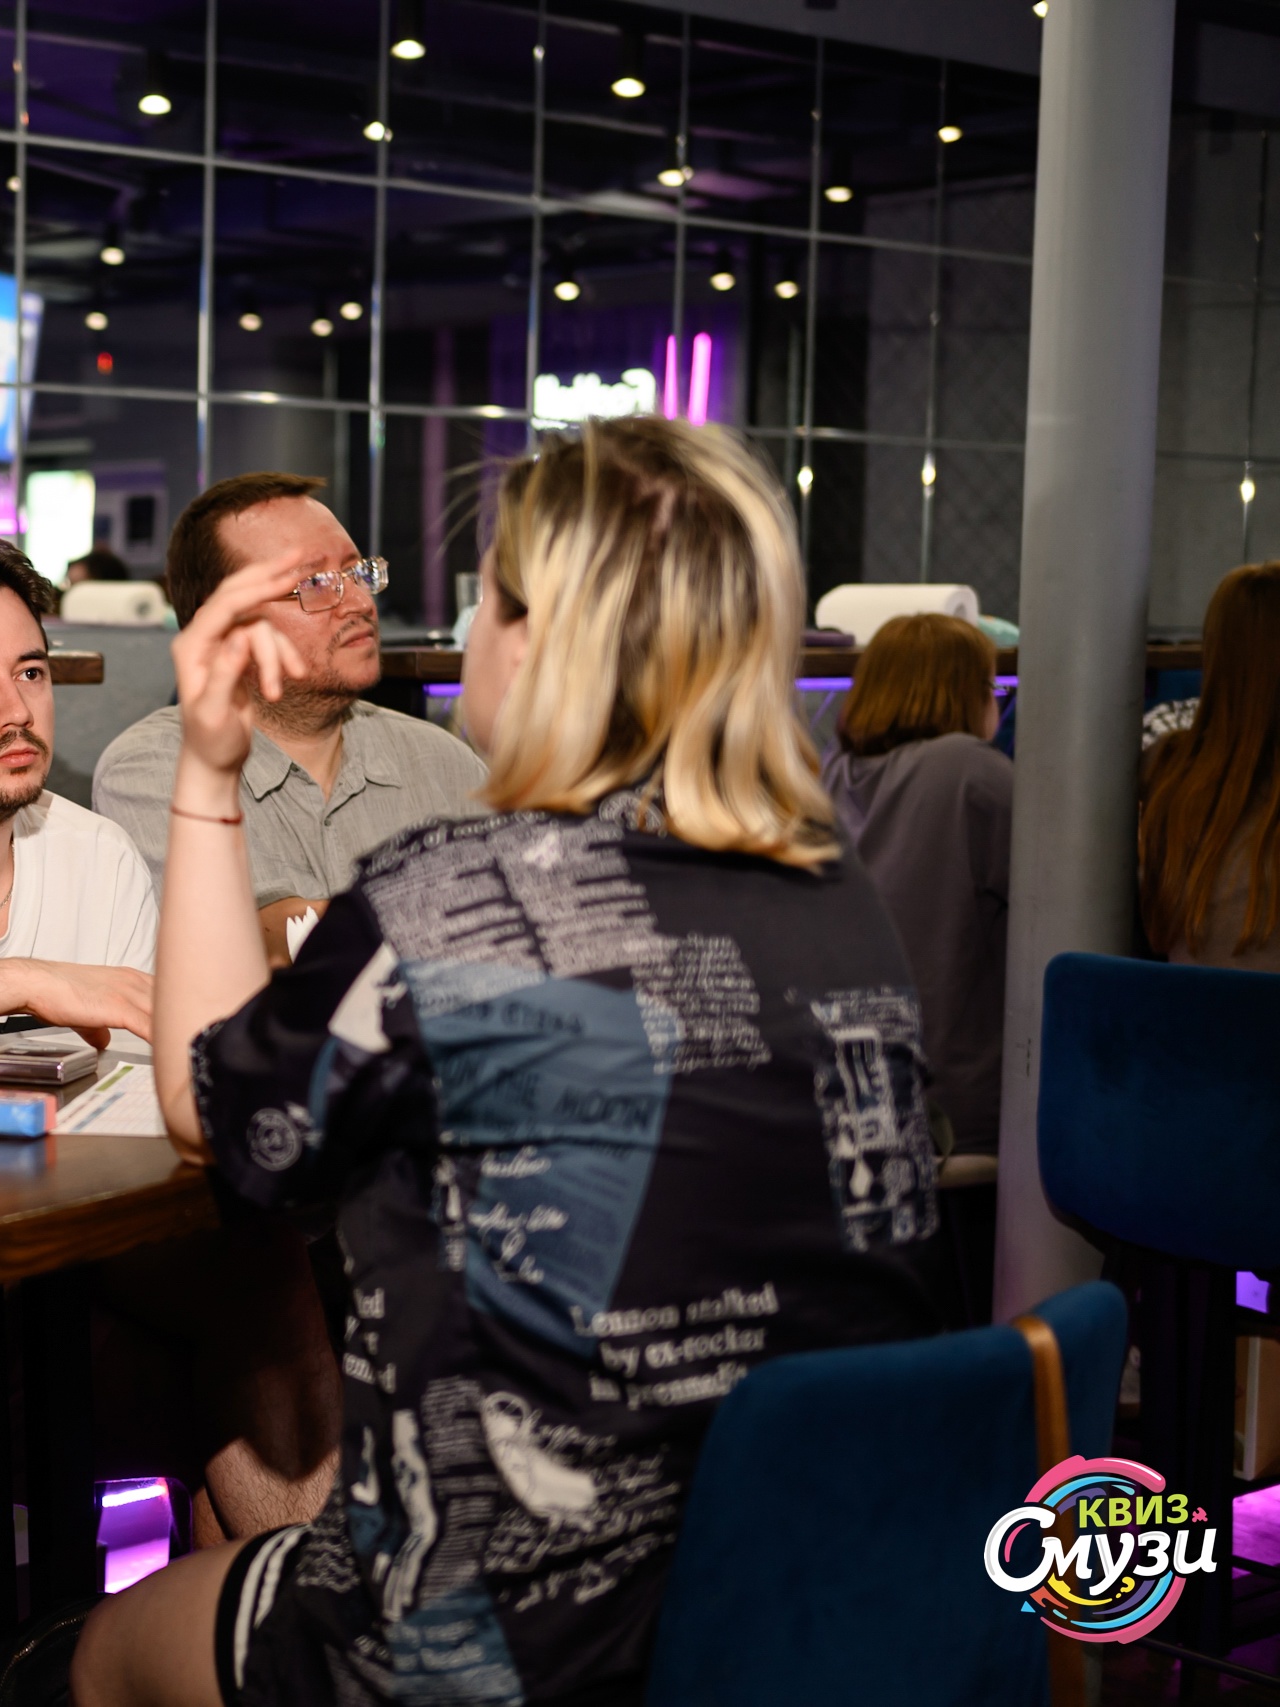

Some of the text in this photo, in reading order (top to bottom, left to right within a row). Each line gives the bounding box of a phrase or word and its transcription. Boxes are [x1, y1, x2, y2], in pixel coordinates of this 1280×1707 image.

[570, 1281, 780, 1338] Lennon stalked
[599, 1324, 766, 1379] by ex-rocker
